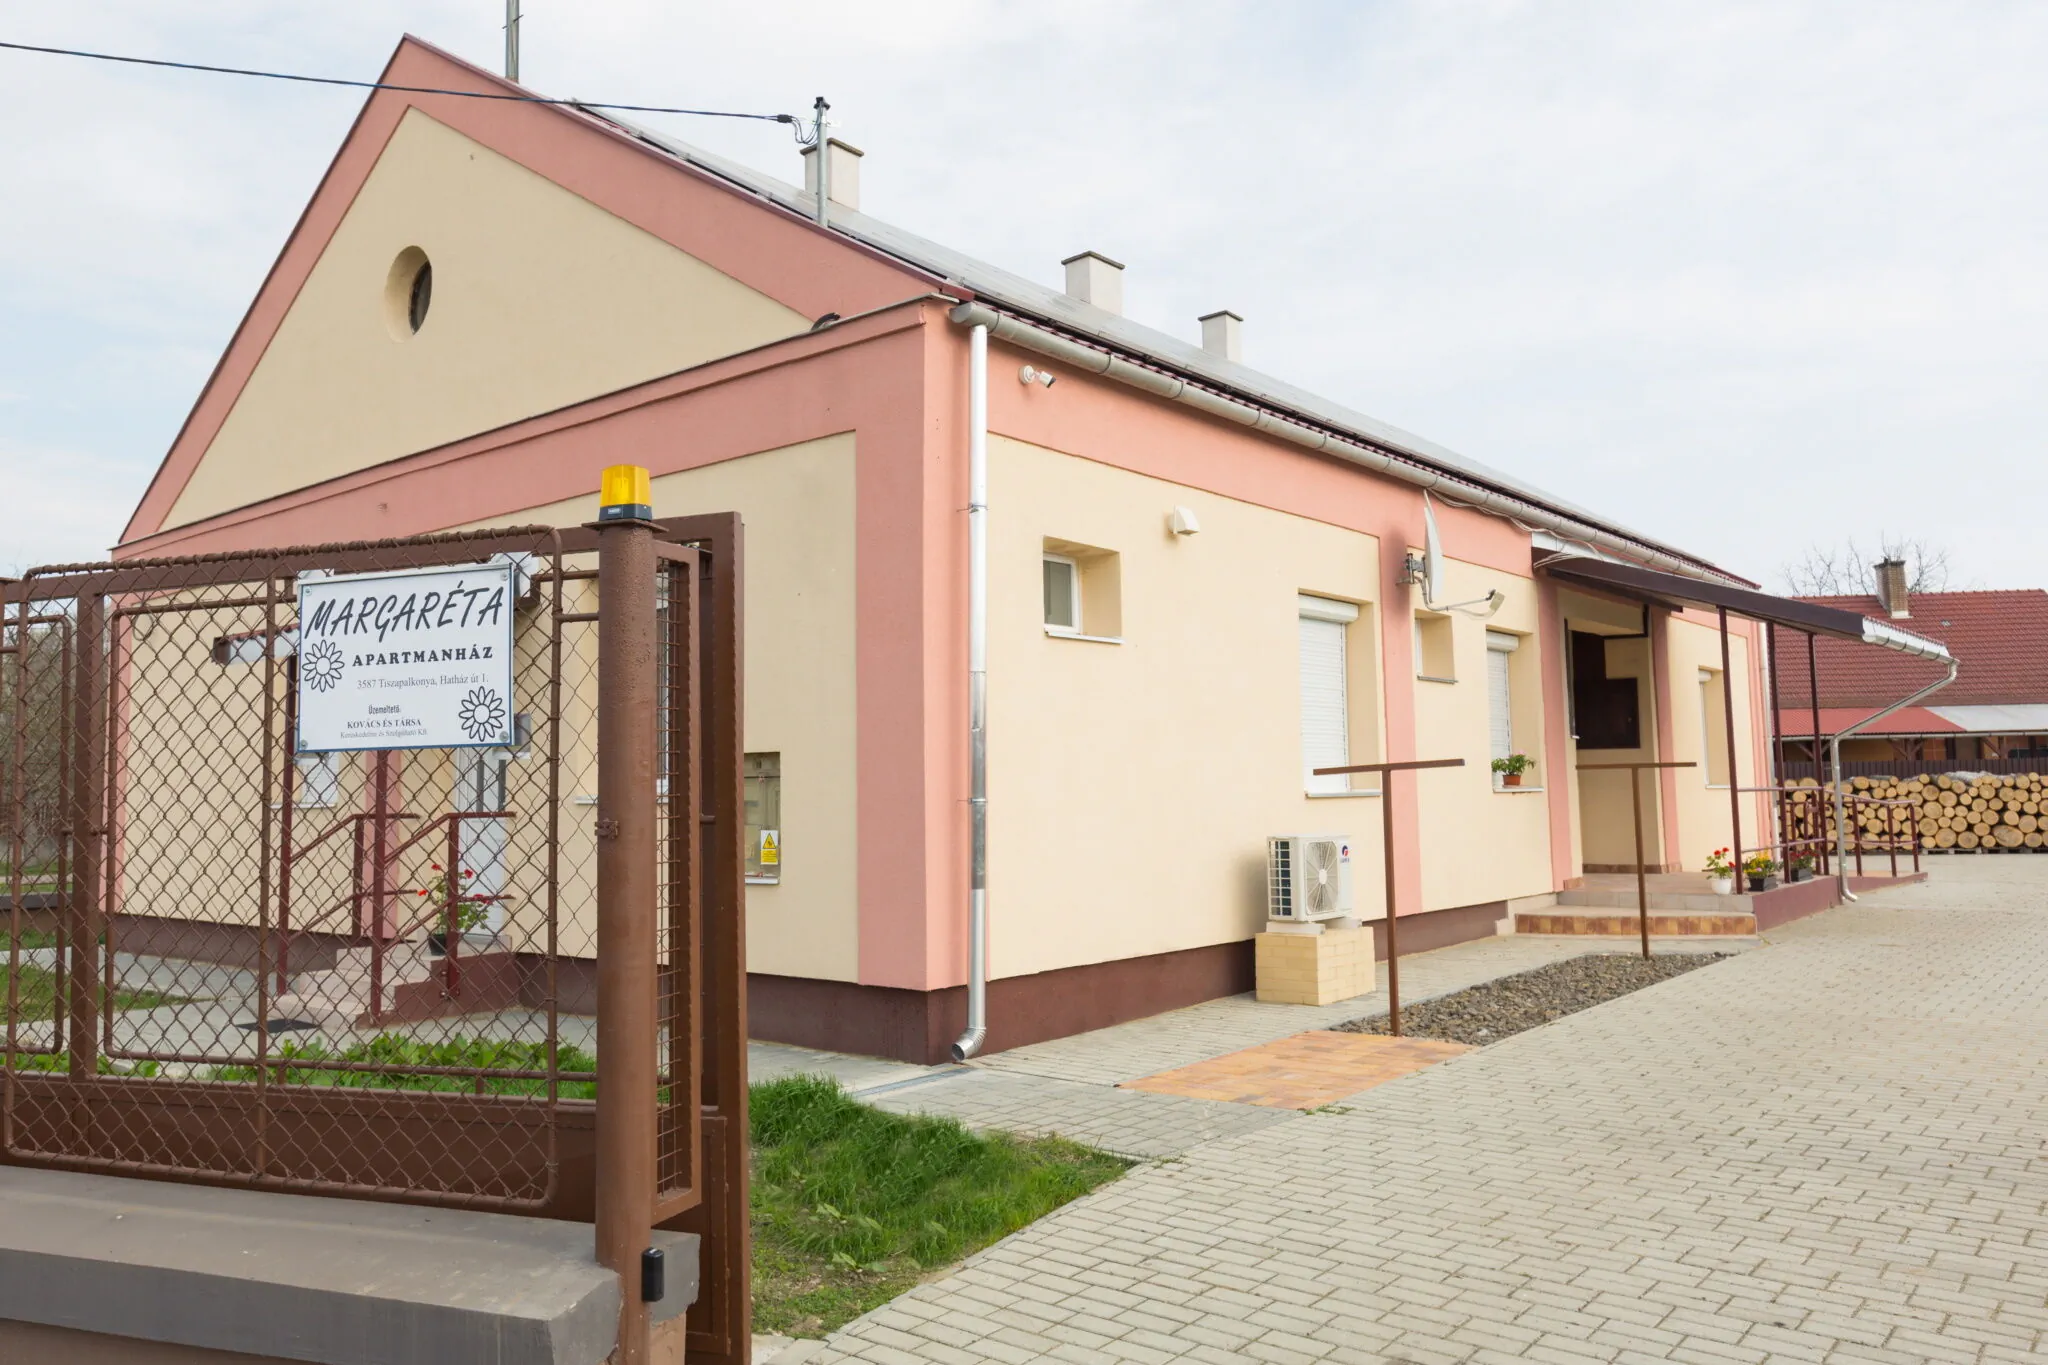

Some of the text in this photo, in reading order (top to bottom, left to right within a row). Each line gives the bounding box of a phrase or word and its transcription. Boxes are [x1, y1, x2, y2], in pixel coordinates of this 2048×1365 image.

[304, 580, 504, 643] MARGARÉTA
[352, 644, 493, 666] APARTMANHÁZ
[357, 679, 376, 689] 3587
[378, 677, 437, 690] Tiszapalkonya,
[440, 674, 468, 685] Hatház
[471, 673, 479, 683] út
[347, 716, 422, 729] KOVÁCS ÉS TÁRSA
